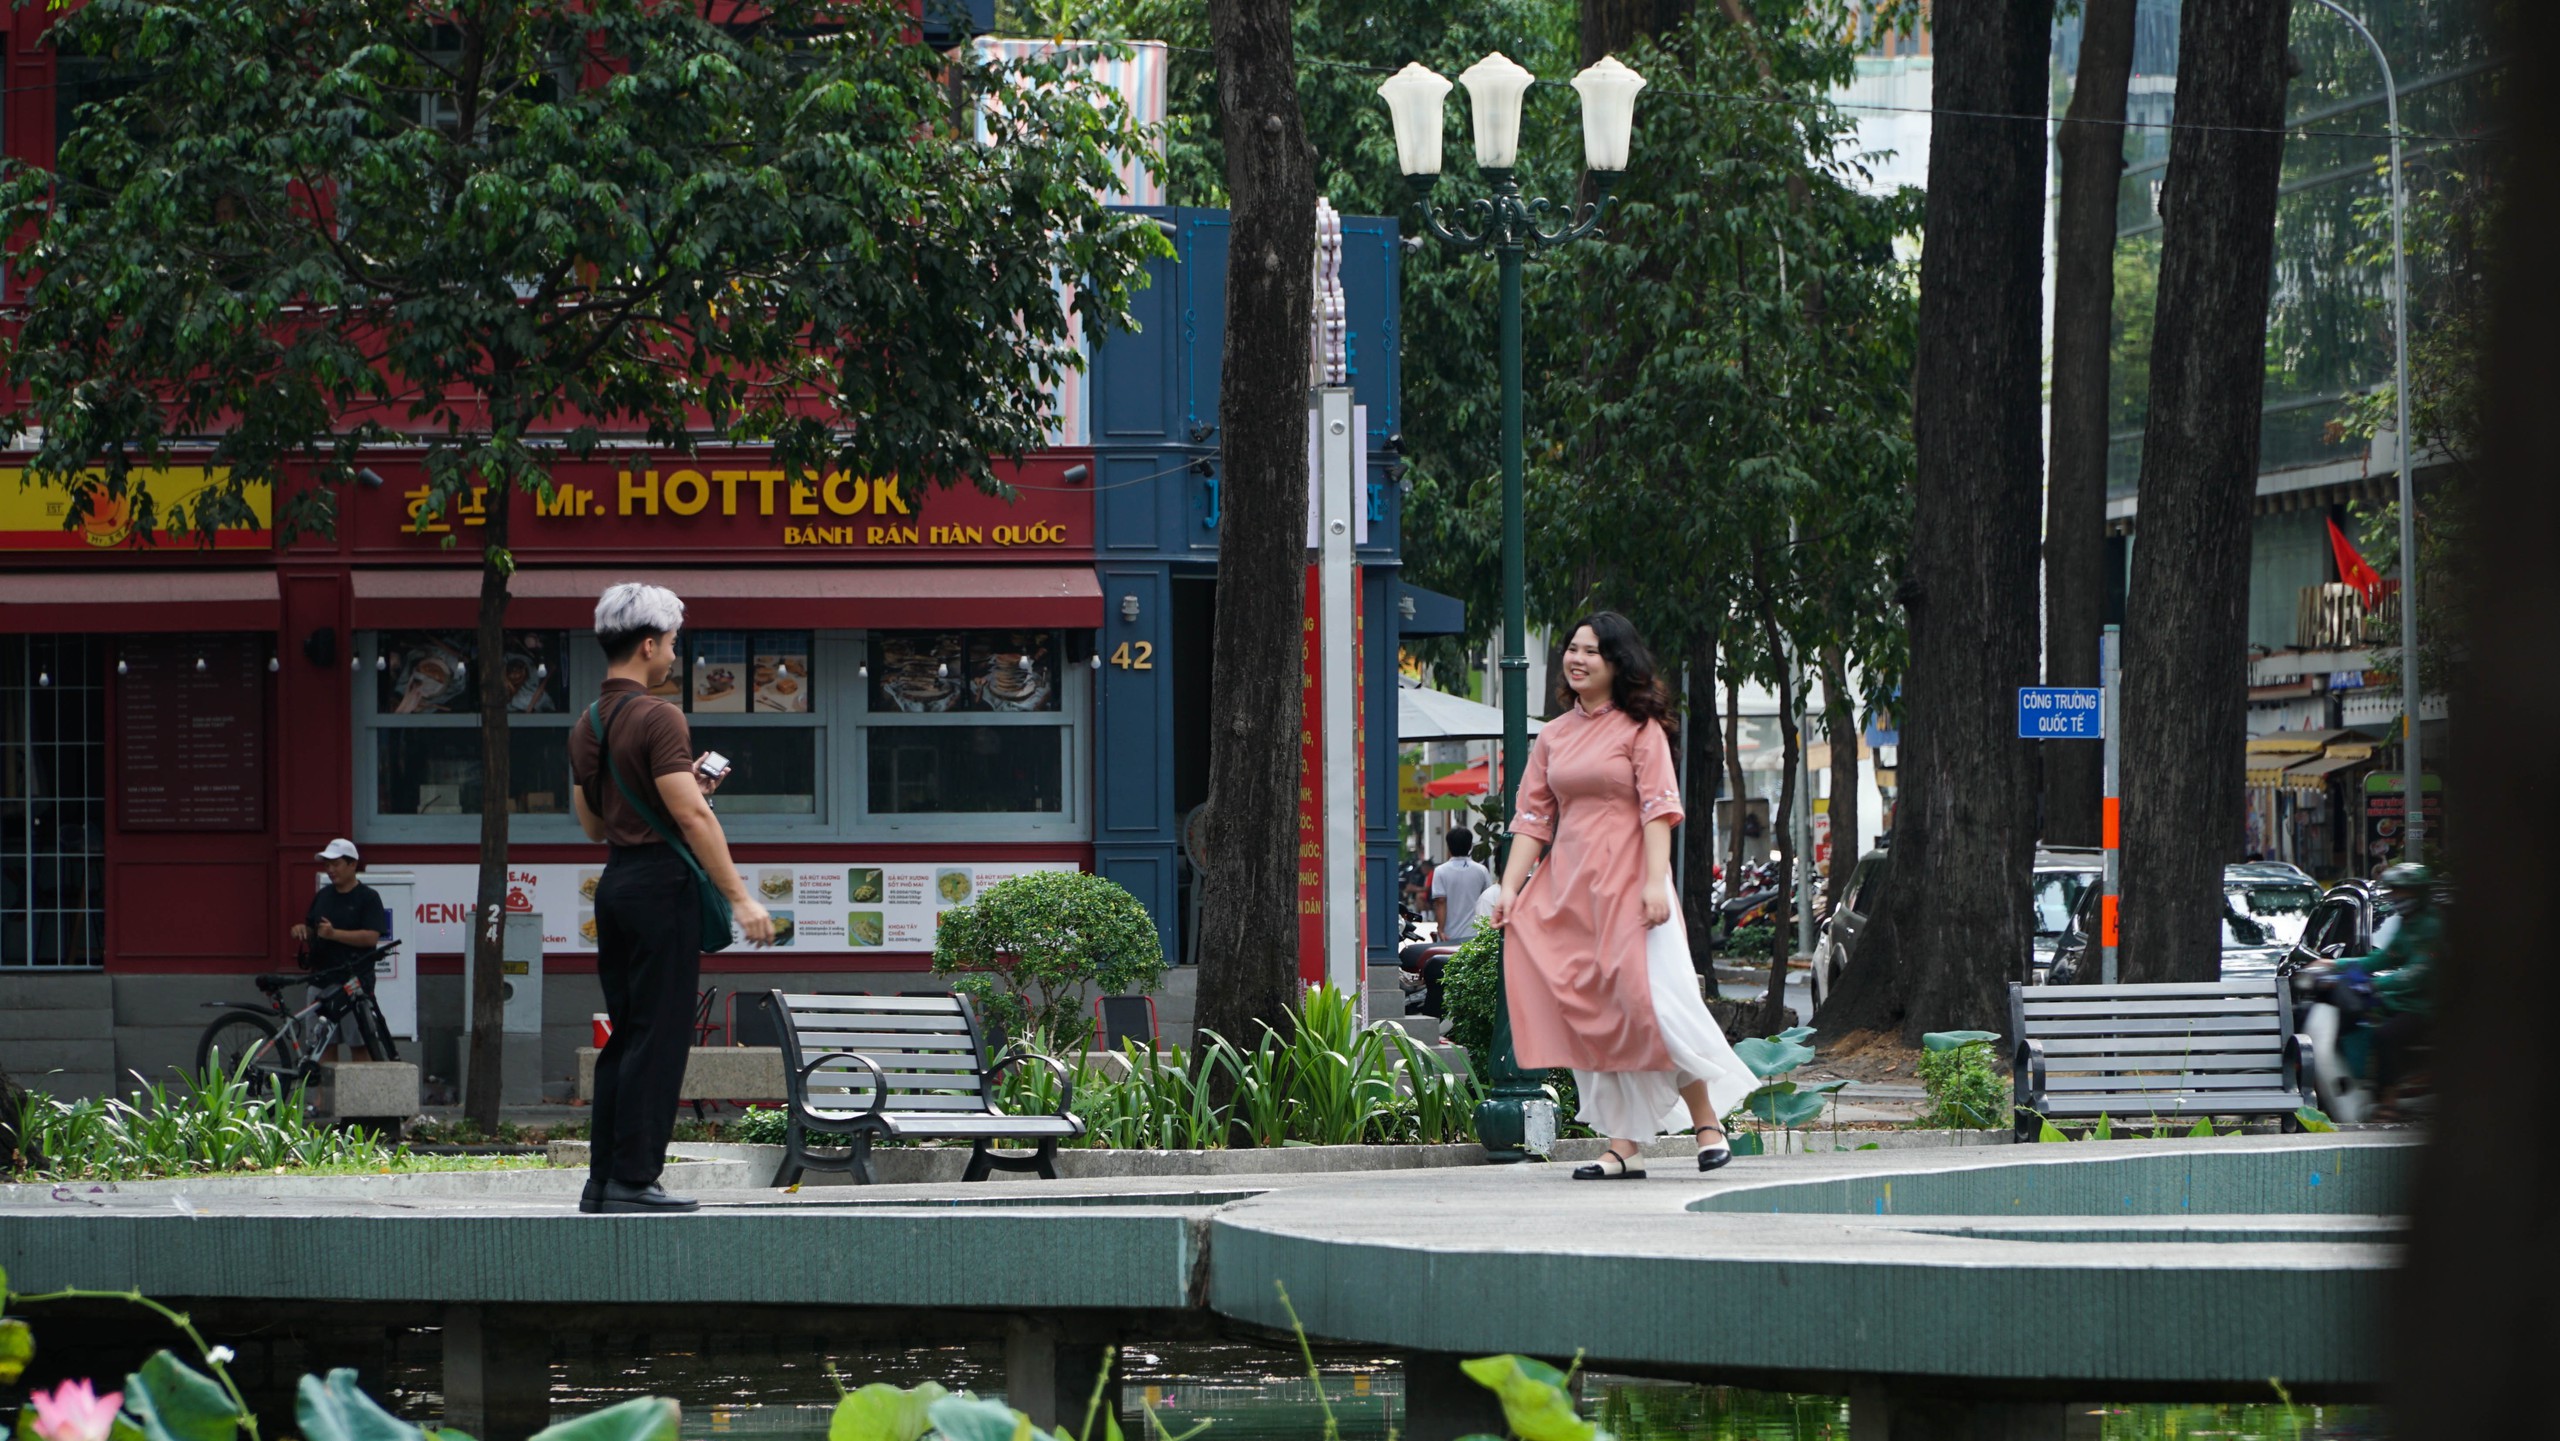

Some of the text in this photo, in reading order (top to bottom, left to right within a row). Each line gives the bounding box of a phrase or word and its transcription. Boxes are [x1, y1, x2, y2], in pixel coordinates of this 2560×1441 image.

[535, 469, 911, 516] Mr. HOTTEOK
[784, 520, 1066, 545] BÁNH RÁN HÀN QUỐC
[1110, 641, 1153, 670] 42
[2023, 690, 2096, 709] CÔNG TRƯỜNG
[2038, 712, 2085, 732] QUỐC TẾ
[1305, 896, 1321, 914] DÂN
